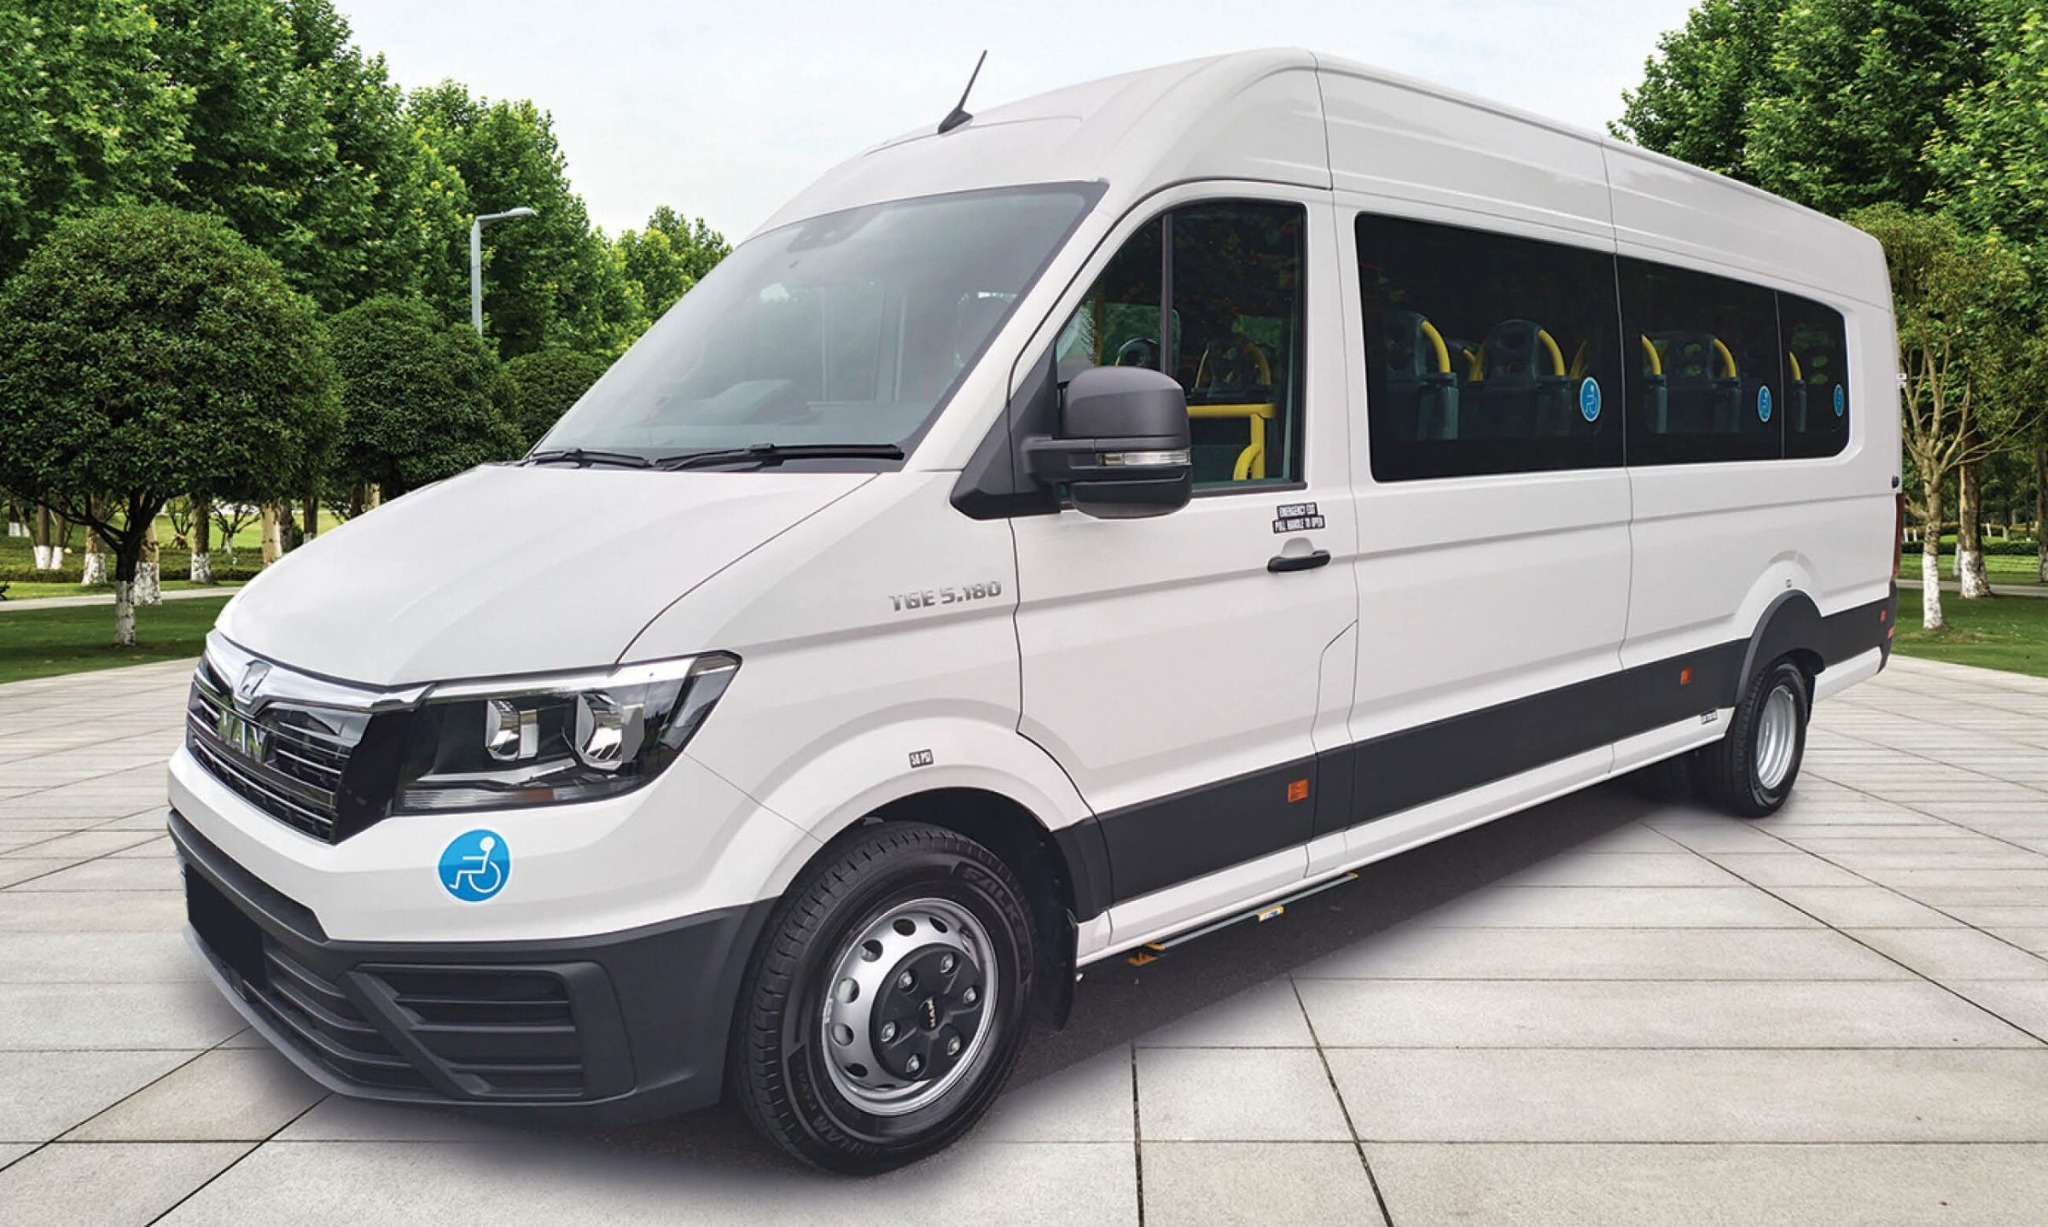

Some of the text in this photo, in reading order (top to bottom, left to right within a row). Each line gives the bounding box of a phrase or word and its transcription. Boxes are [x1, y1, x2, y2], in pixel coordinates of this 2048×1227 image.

[888, 580, 1002, 612] TGE 5.180
[217, 707, 268, 764] MAN
